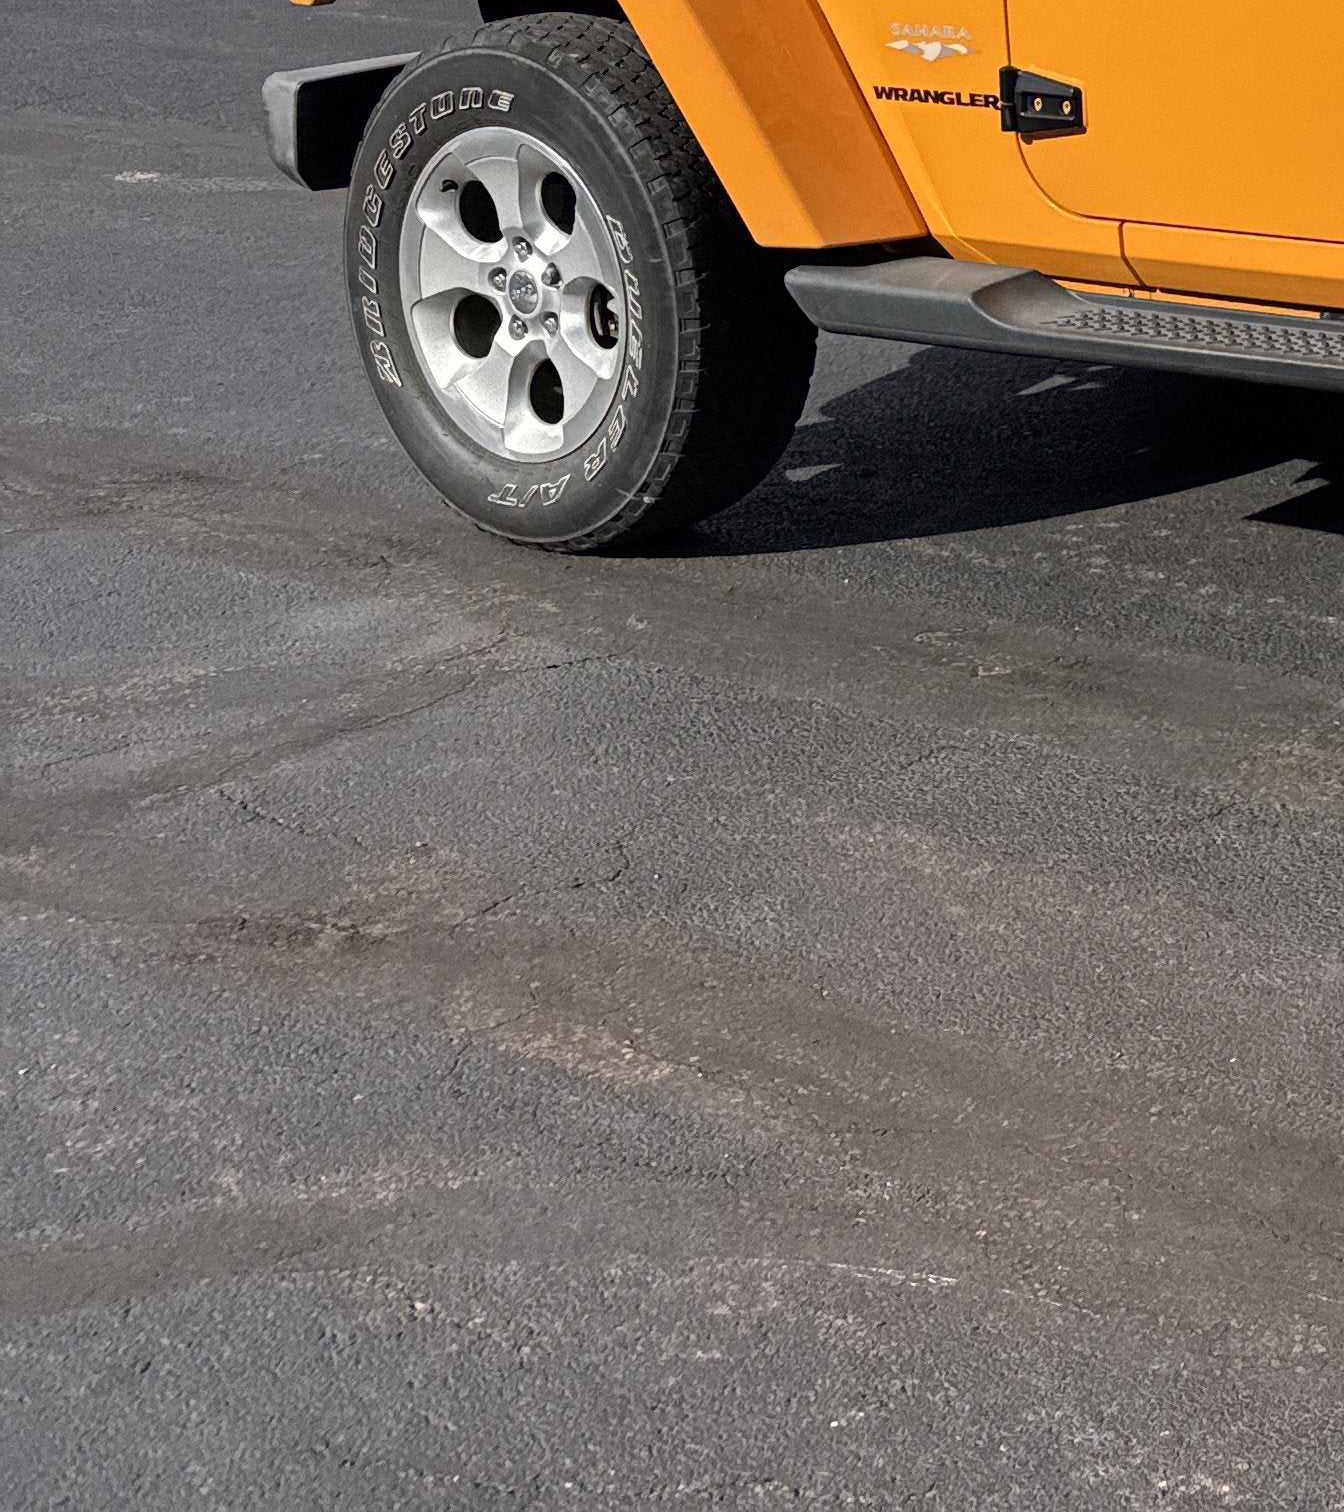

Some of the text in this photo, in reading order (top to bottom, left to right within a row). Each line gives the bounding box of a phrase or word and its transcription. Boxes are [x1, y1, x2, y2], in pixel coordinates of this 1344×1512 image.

[890, 22, 972, 40] SAHARA
[873, 85, 1002, 111] WRANGLER
[355, 86, 515, 388] BRIDGESTONE
